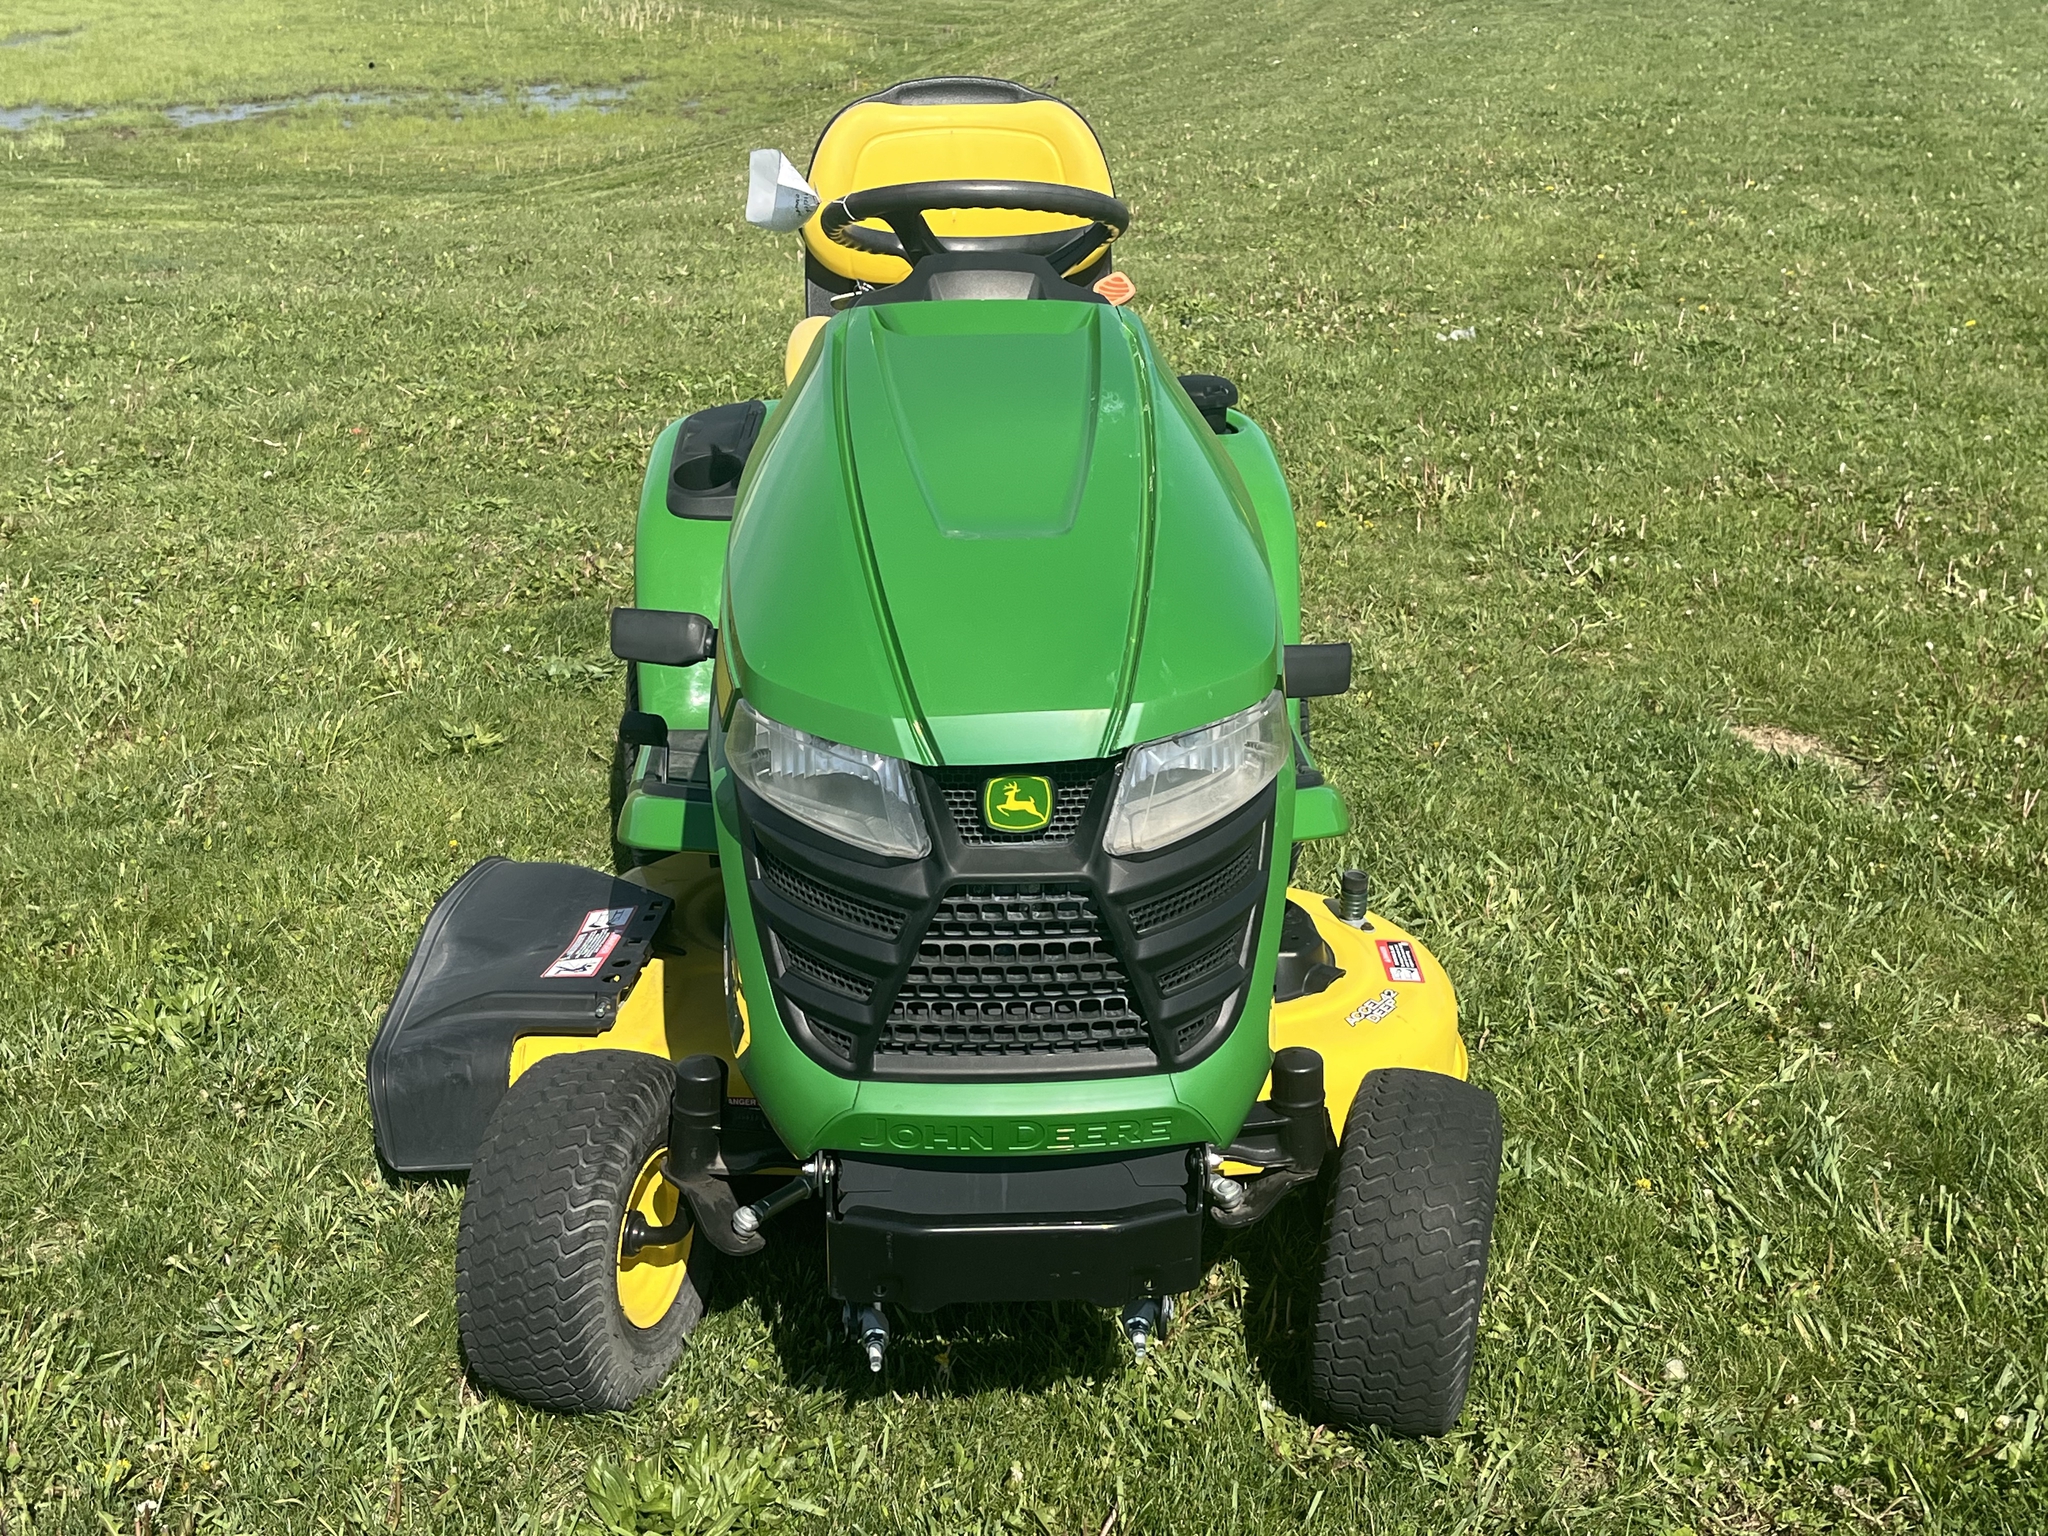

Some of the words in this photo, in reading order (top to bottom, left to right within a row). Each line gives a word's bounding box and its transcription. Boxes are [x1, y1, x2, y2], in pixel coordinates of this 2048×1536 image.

[1365, 997, 1397, 1024] DEEP
[728, 1098, 757, 1106] ANGER
[860, 1117, 993, 1150] JOHN
[1008, 1116, 1172, 1150] DEERE
